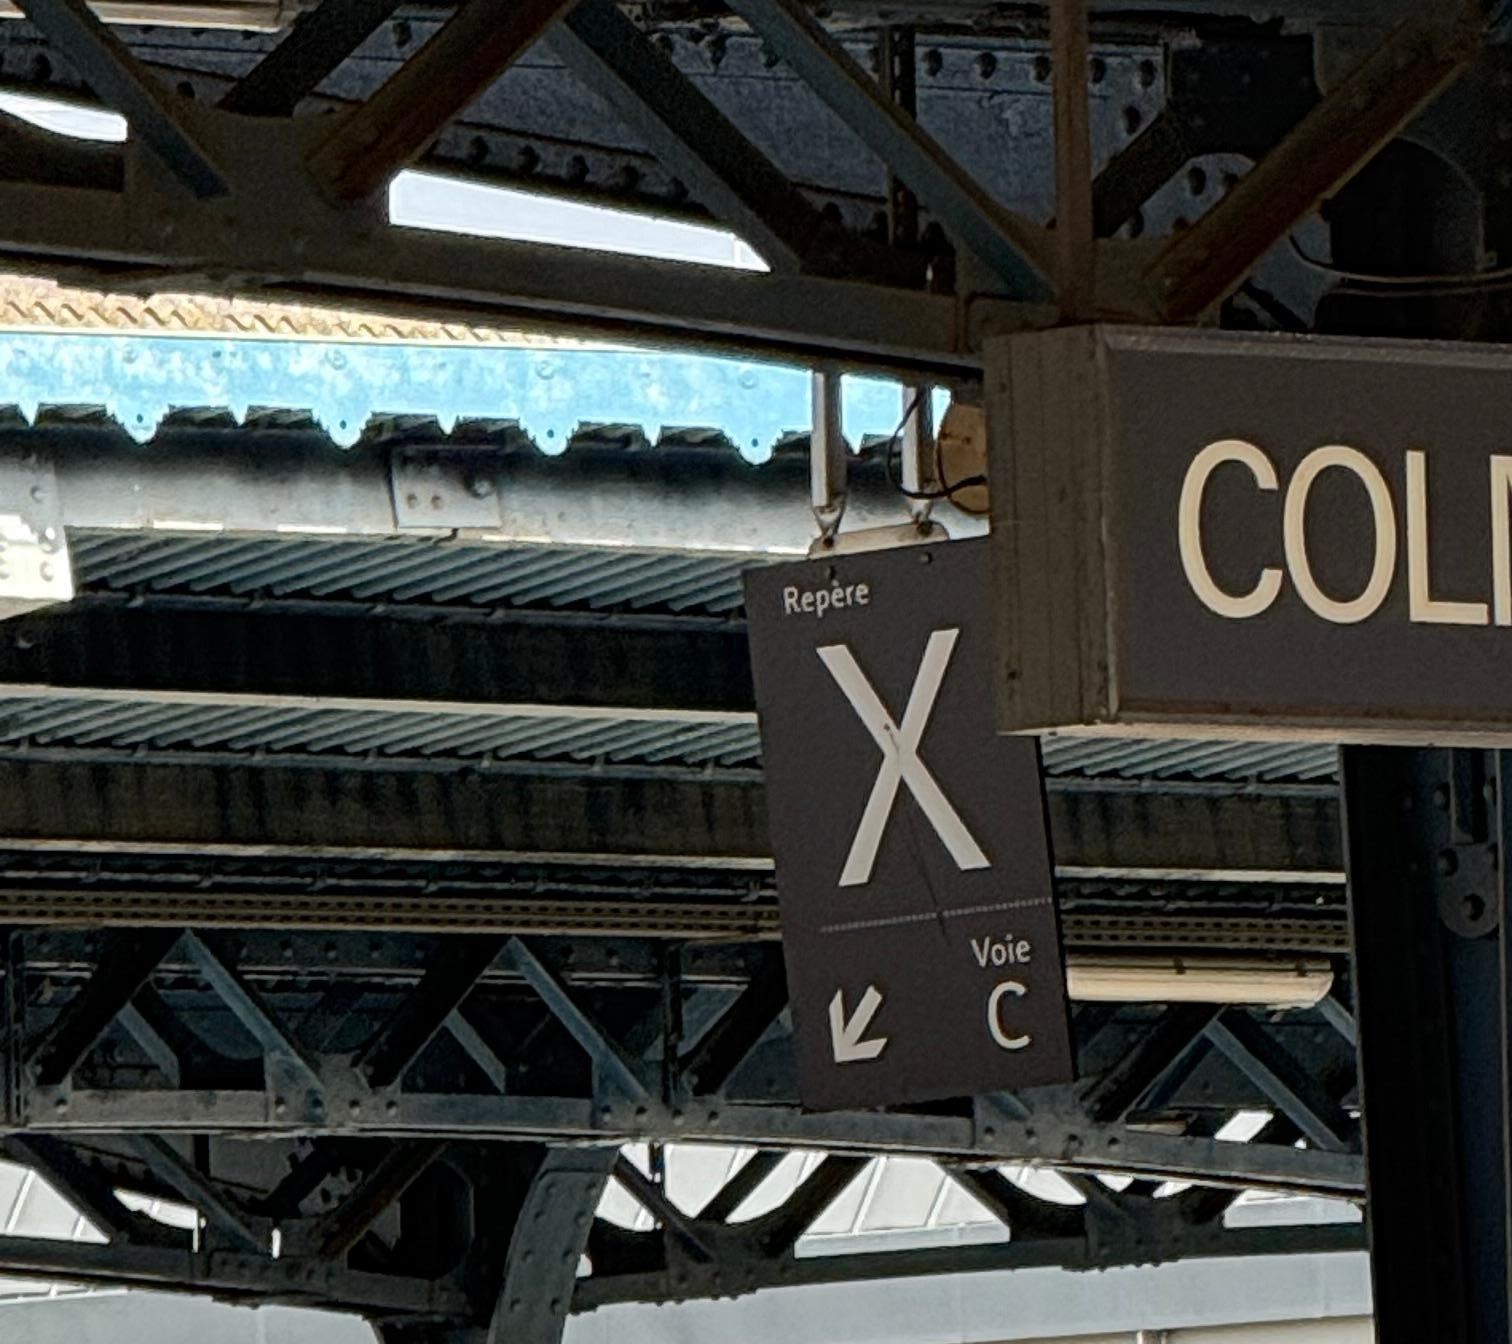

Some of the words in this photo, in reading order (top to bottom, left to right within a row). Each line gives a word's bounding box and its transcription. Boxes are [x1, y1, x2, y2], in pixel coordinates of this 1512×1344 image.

[783, 580, 870, 617] Repère
[816, 628, 991, 887] X
[971, 933, 1031, 967] Voie
[987, 980, 1030, 1049] C
